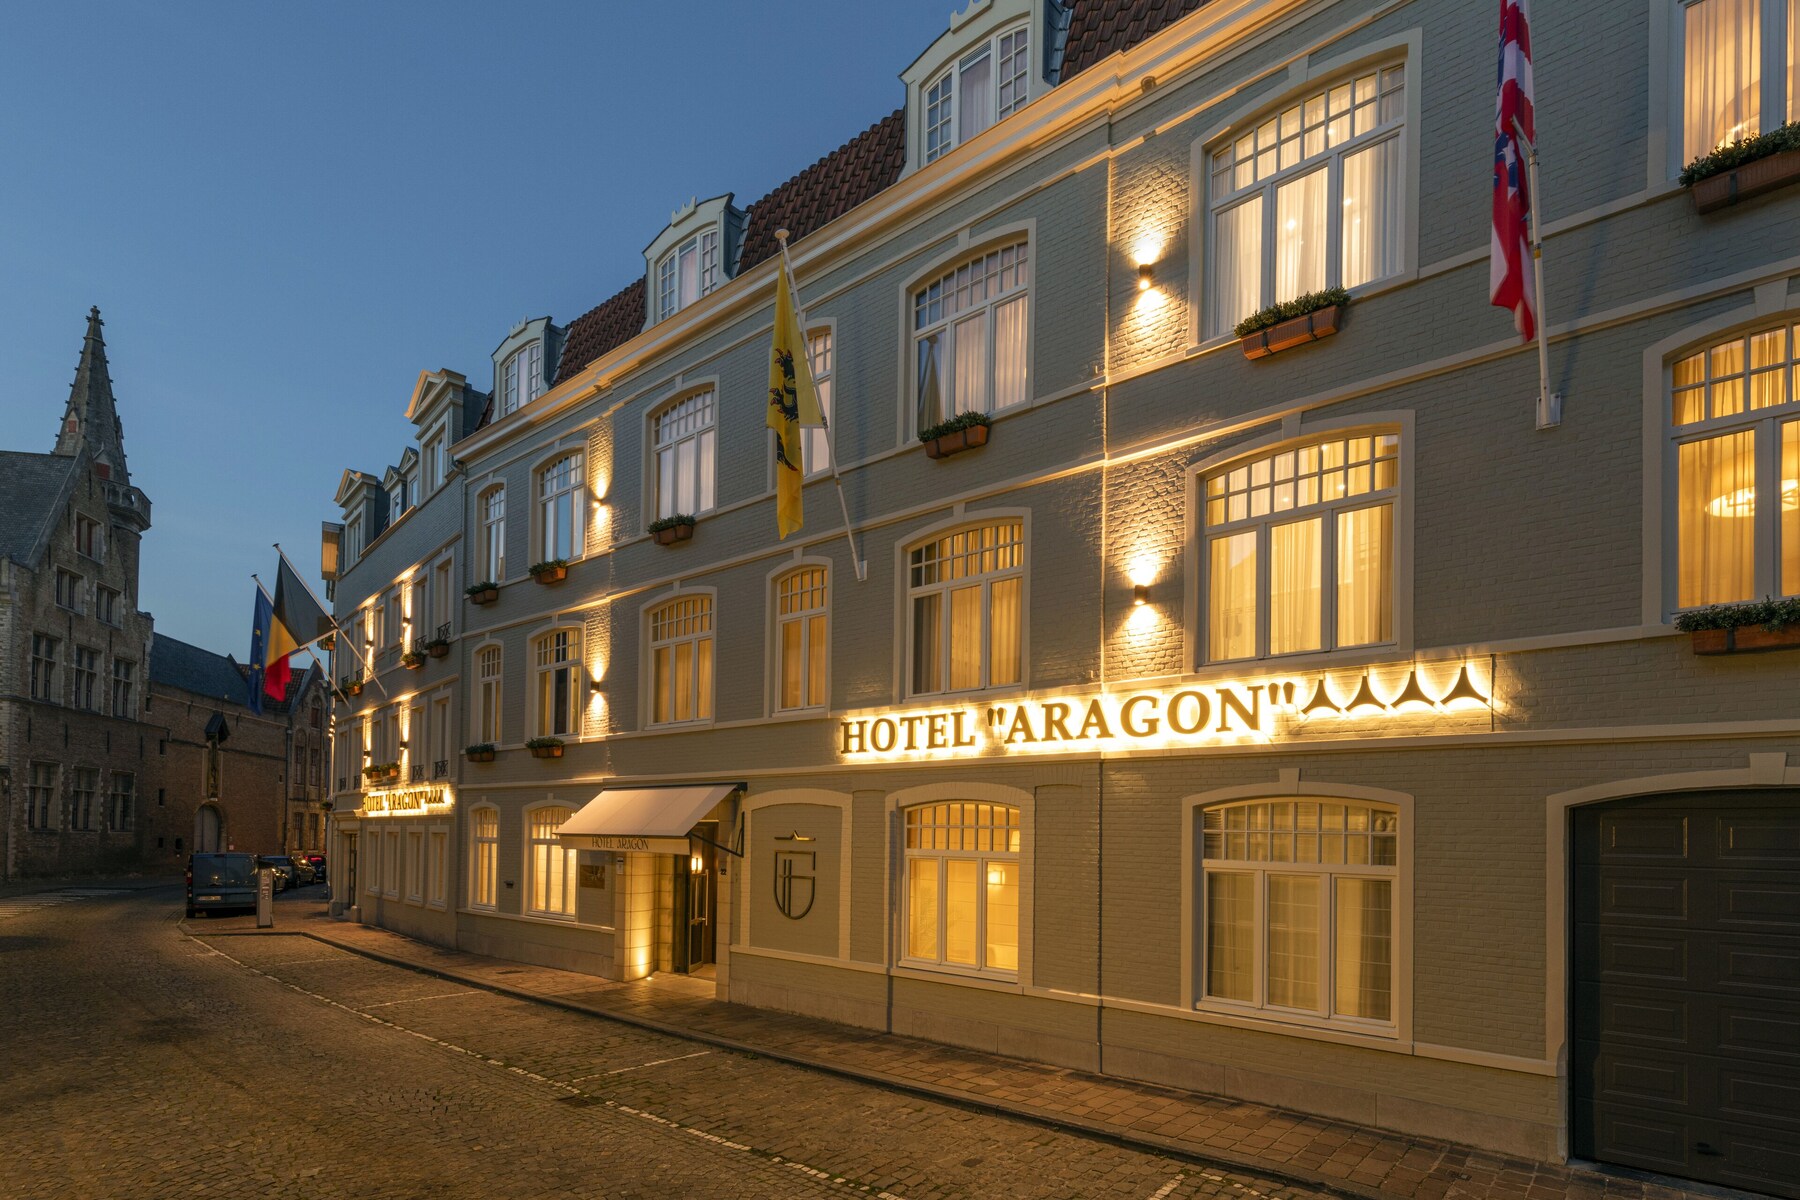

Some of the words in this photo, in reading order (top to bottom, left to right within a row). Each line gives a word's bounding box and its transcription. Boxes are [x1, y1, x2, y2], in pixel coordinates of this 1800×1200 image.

[841, 711, 976, 754] HOTEL
[363, 795, 384, 812] HOTEL
[591, 837, 614, 849] HOTEL
[616, 838, 649, 850] ARAGON
